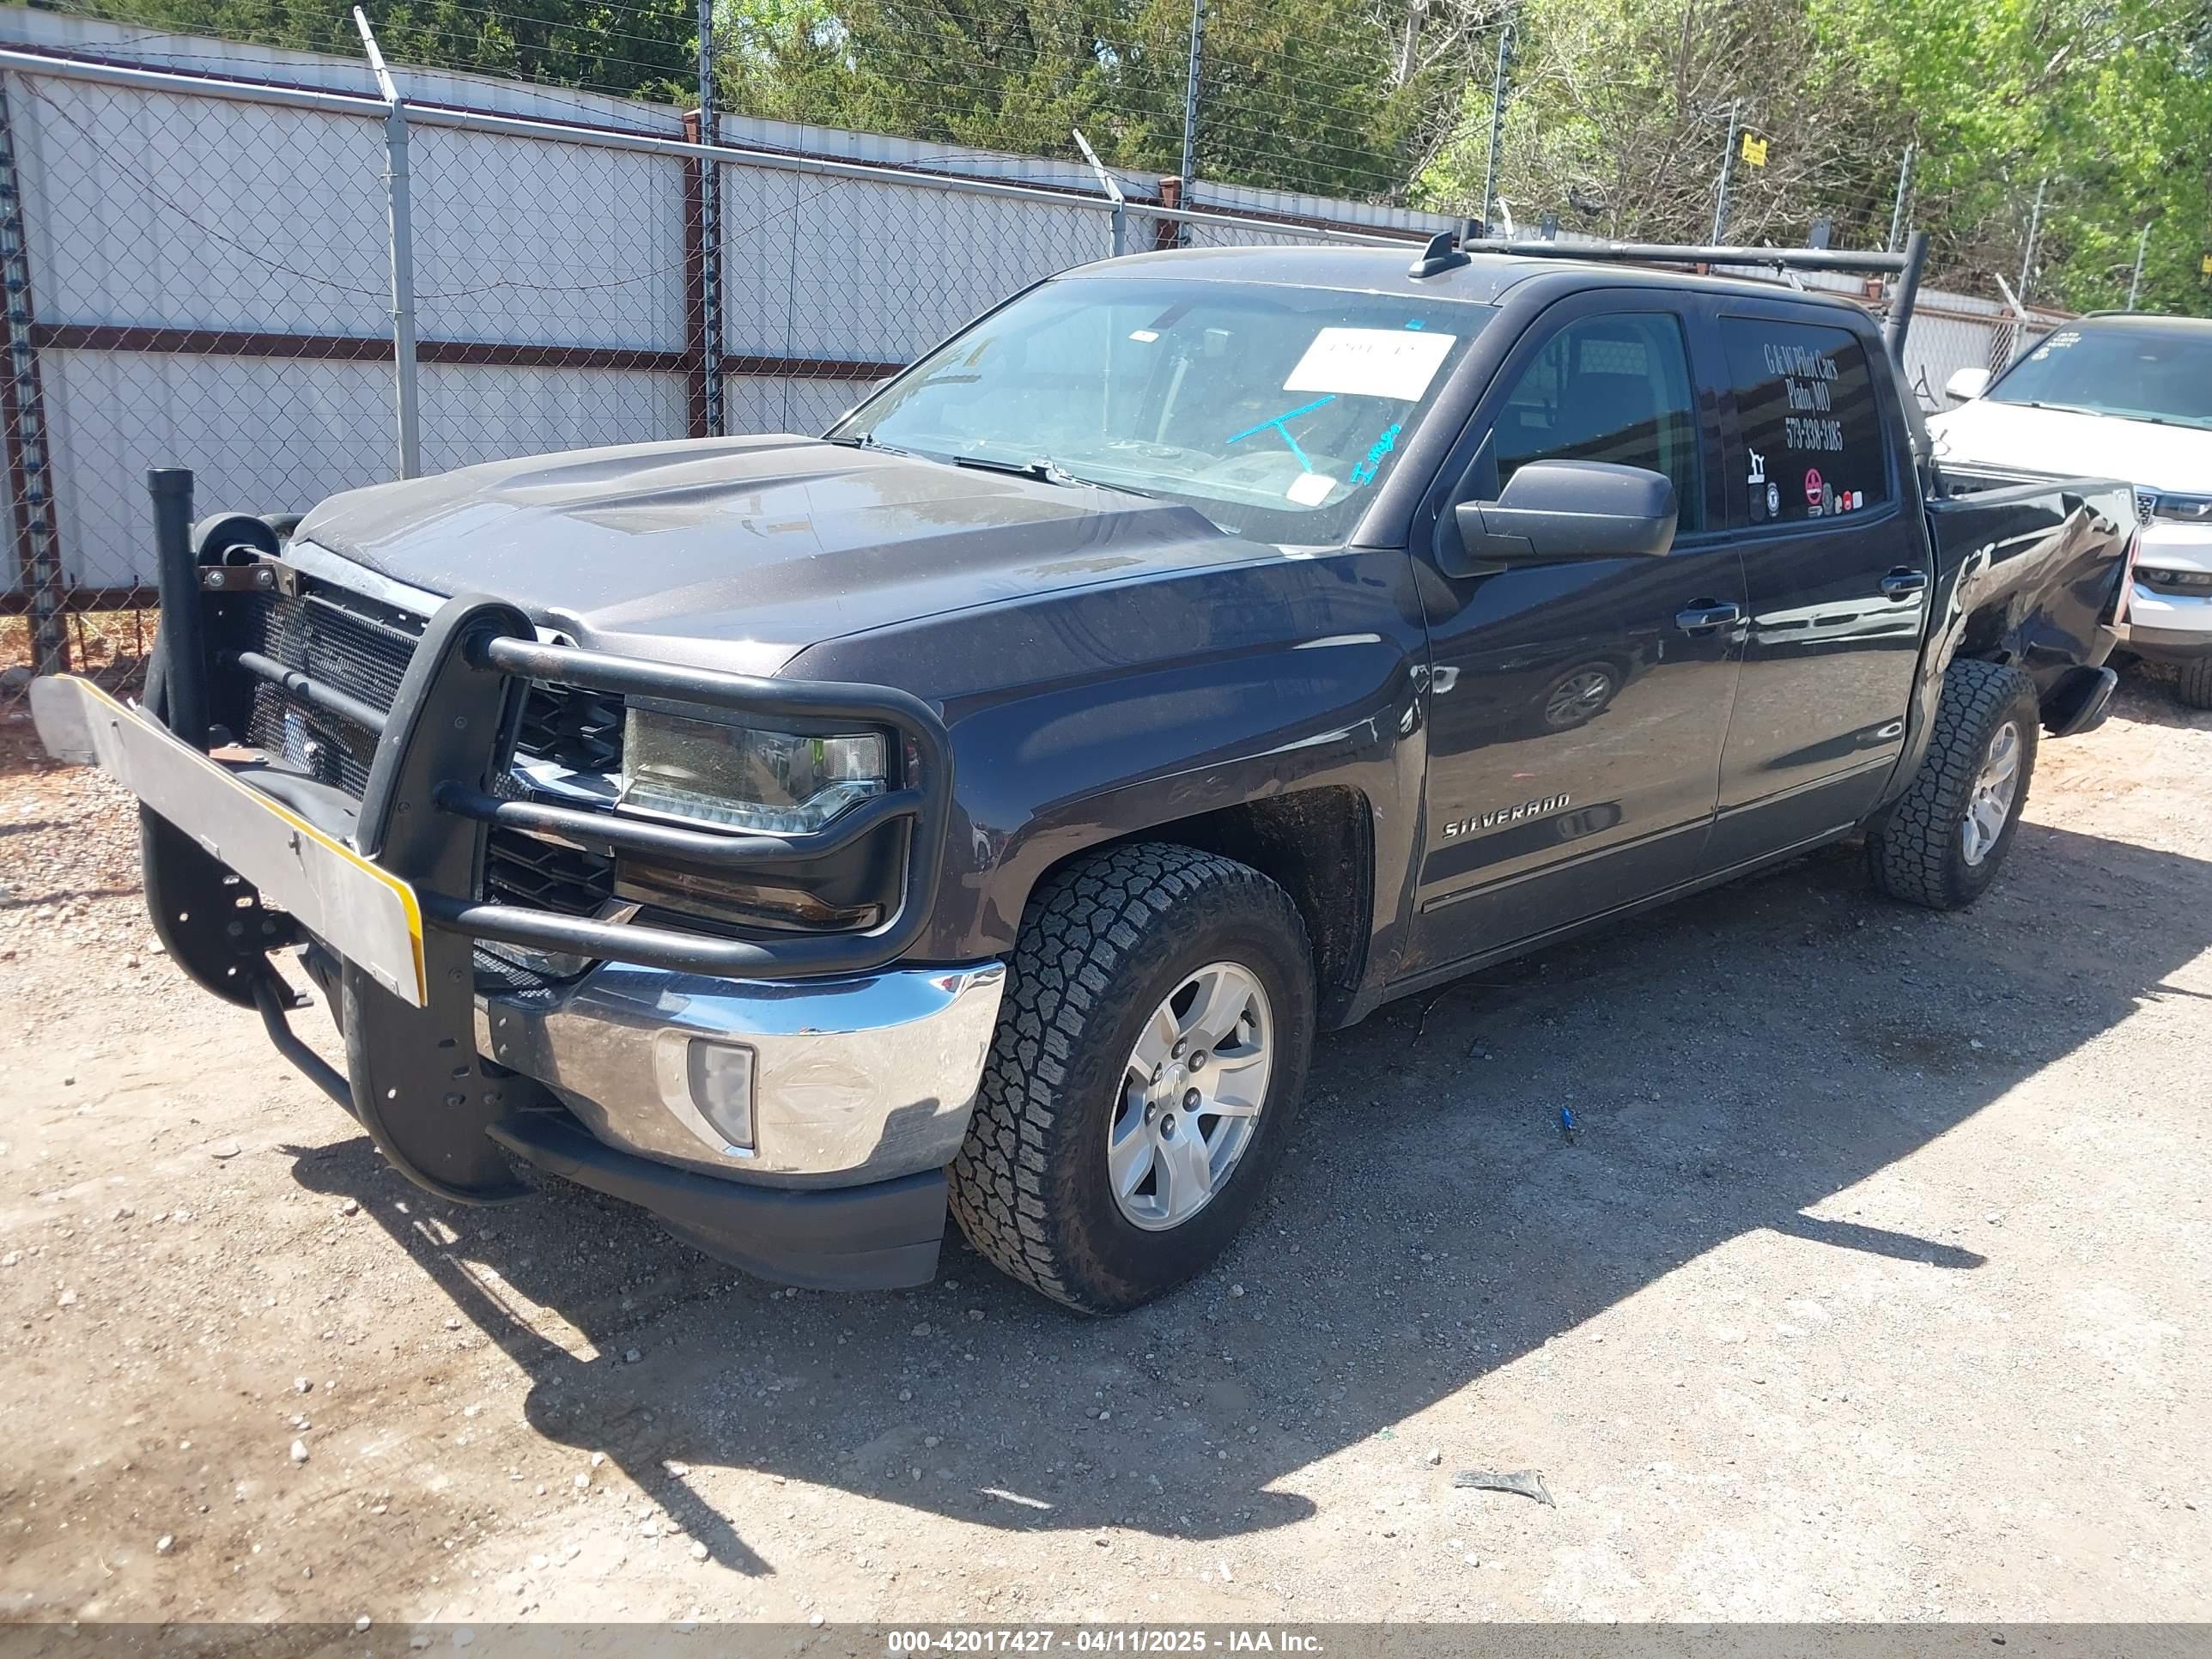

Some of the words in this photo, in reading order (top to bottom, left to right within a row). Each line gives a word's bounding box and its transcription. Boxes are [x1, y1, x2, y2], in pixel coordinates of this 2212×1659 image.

[1792, 345, 1819, 379] Pilot
[1814, 349, 1838, 380] Cars
[1785, 377, 1815, 418] Plato,
[1812, 380, 1831, 411] MO
[1785, 417, 1843, 451] 573-338-3185
[1443, 792, 1570, 840] SILVERADO
